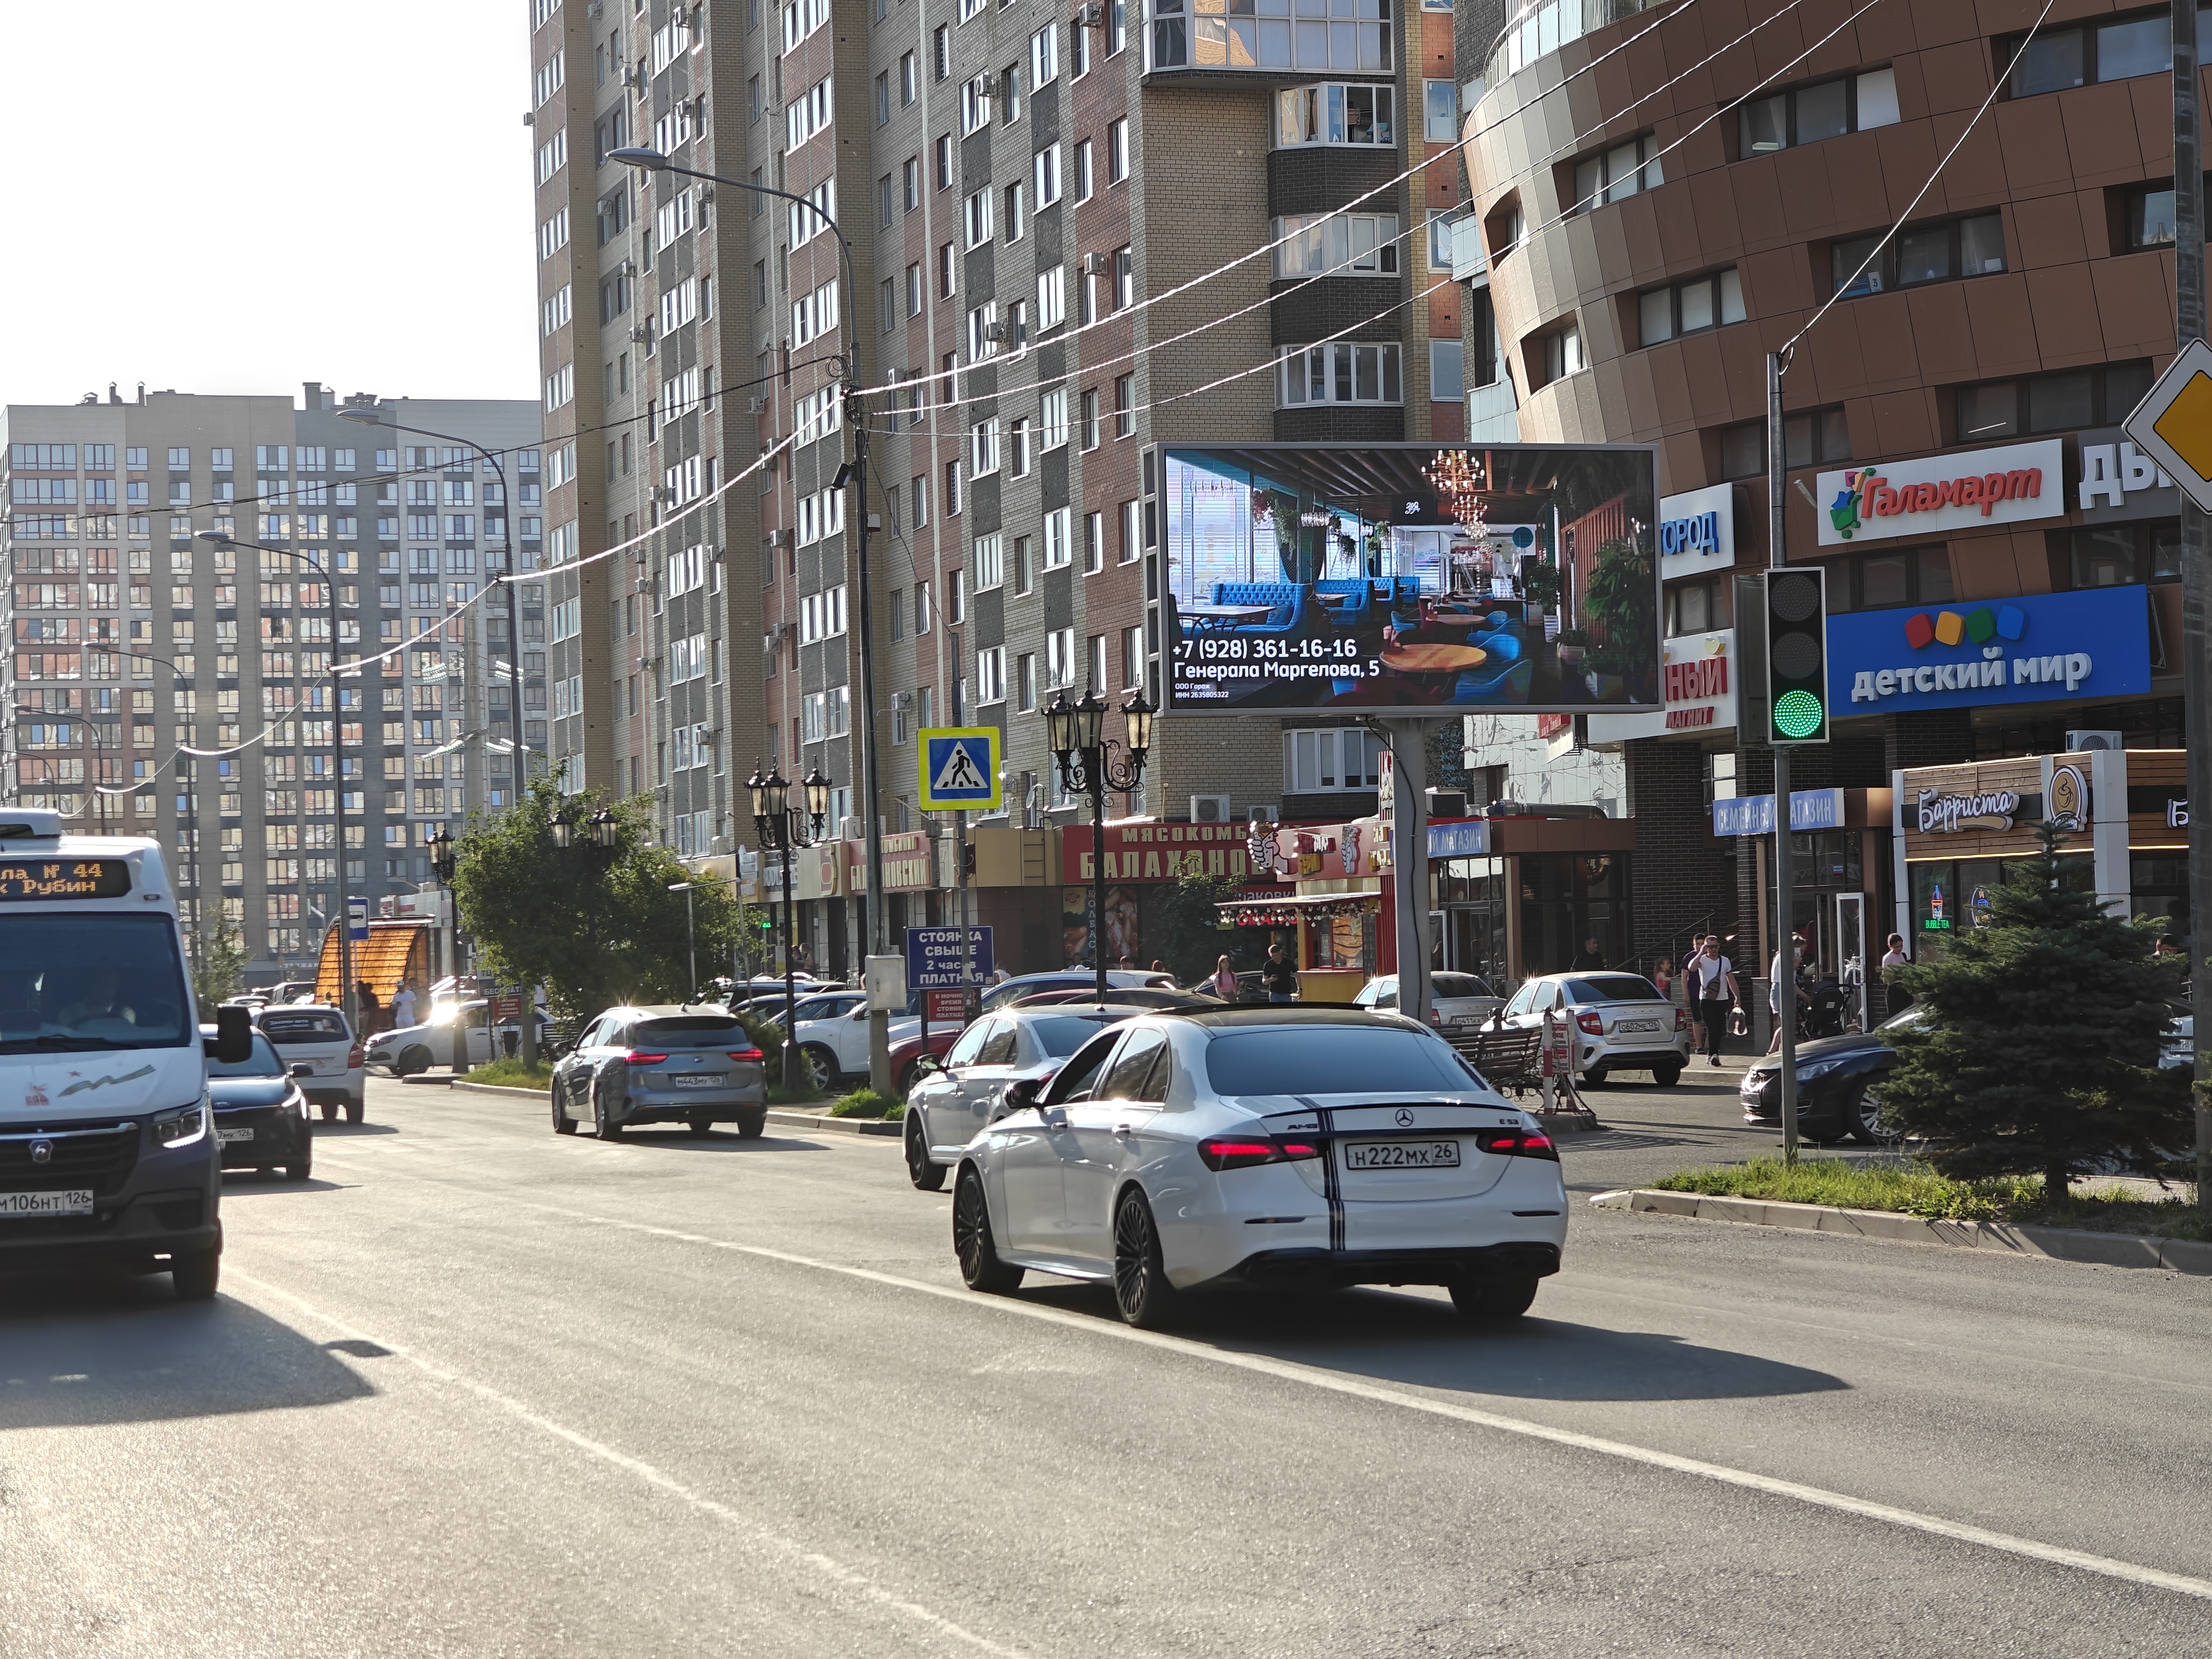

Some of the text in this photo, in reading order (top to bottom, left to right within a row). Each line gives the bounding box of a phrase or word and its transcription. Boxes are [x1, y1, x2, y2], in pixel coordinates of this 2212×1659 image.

[1861, 467, 2043, 518] Галамарт
[1660, 511, 1719, 556] ОРОД
[1173, 638, 1357, 659] +7 (928) 361-16-16
[1174, 660, 1380, 681] Генерала Маргелова, 5
[1851, 646, 2092, 703] детский мир
[1190, 683, 1211, 691] Гараж
[1665, 706, 1714, 729] МАГНИТ
[1790, 797, 1832, 825] АГАЗИН
[1918, 788, 2020, 833] Барриста
[73, 863, 103, 878] 44
[851, 852, 929, 890] БАЛНОВСКИЙ
[23, 878, 96, 894] Рубин
[926, 960, 976, 970] 2 часв
[1355, 1144, 1452, 1166] Н222МХ 26
[65, 1191, 90, 1204] 126
